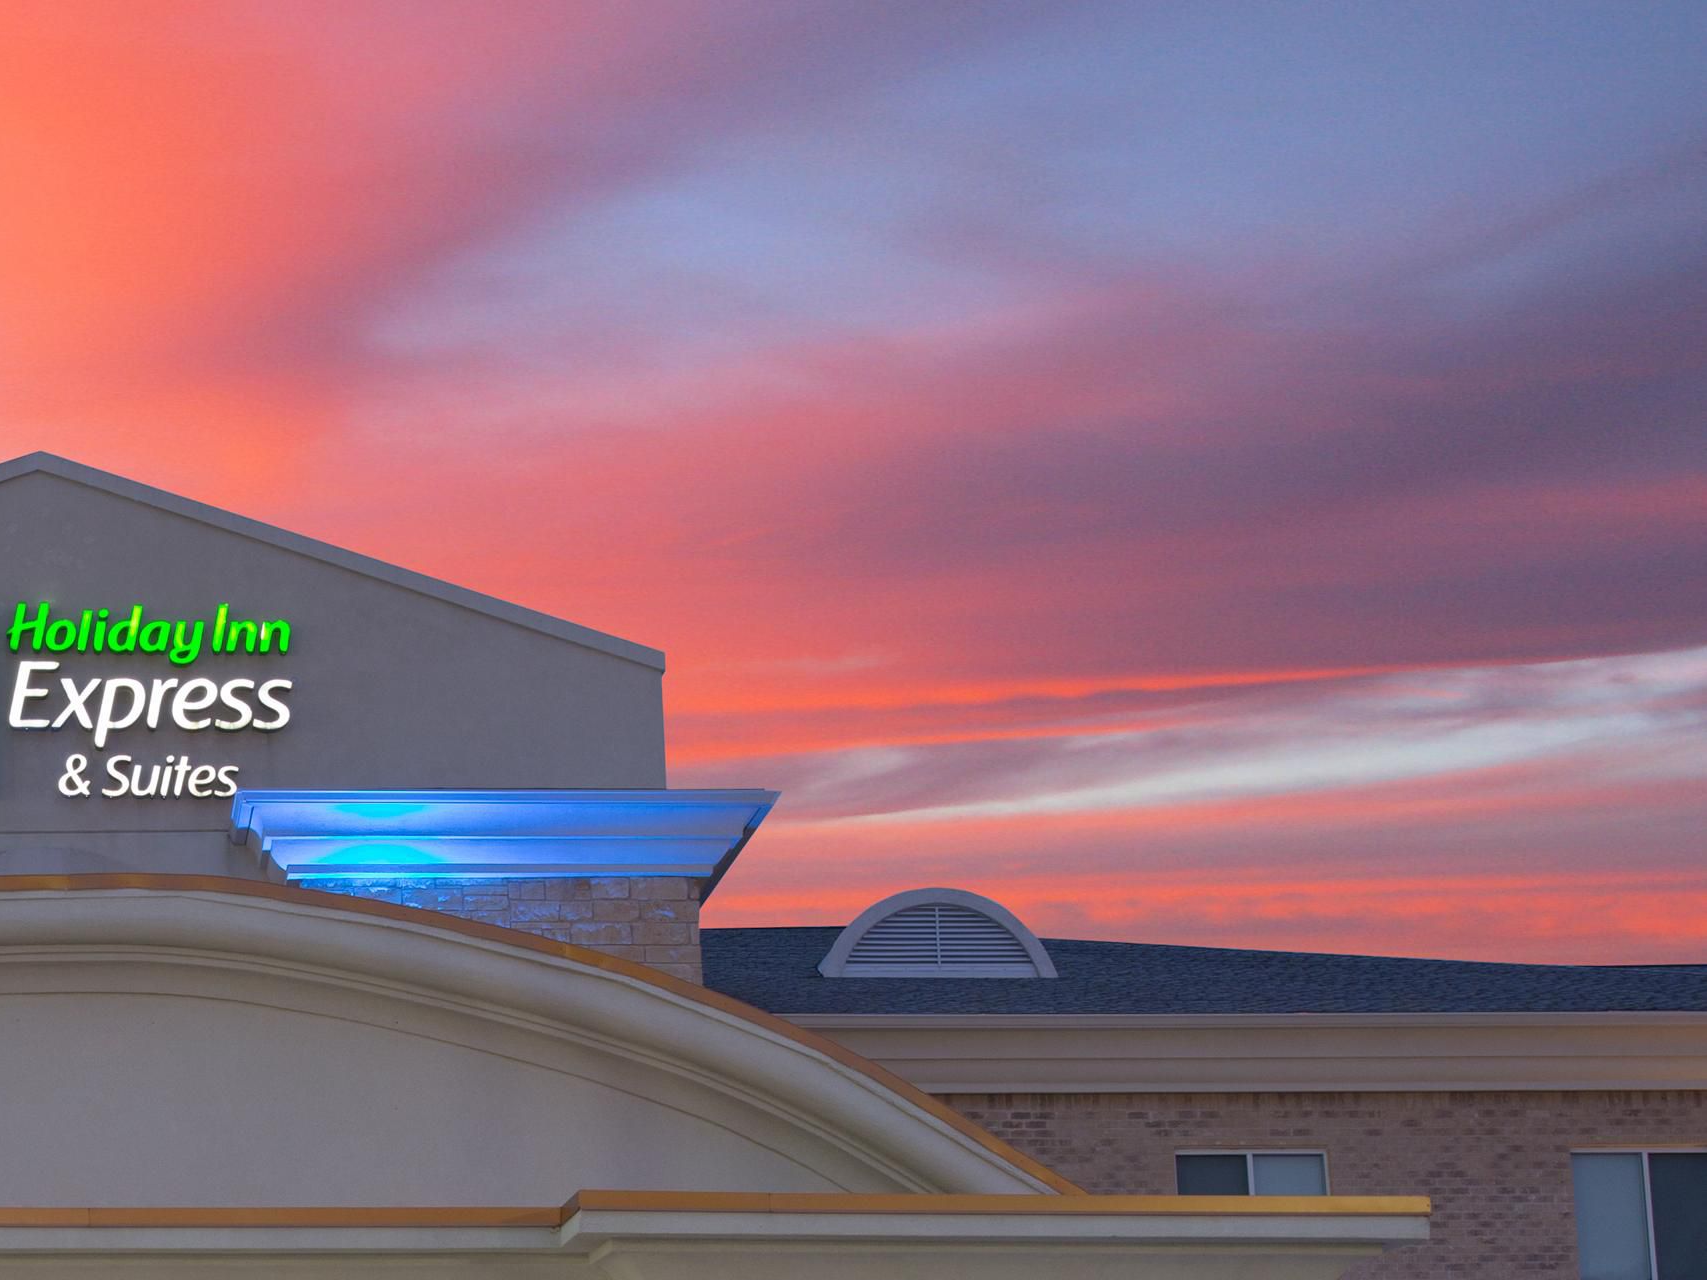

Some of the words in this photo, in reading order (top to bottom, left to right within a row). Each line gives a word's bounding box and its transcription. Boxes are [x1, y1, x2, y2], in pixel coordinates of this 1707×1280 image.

[5, 601, 206, 666] Holiday
[211, 602, 292, 655] Inn
[8, 660, 293, 748] Express
[57, 753, 91, 798] &
[101, 753, 240, 798] Suites
